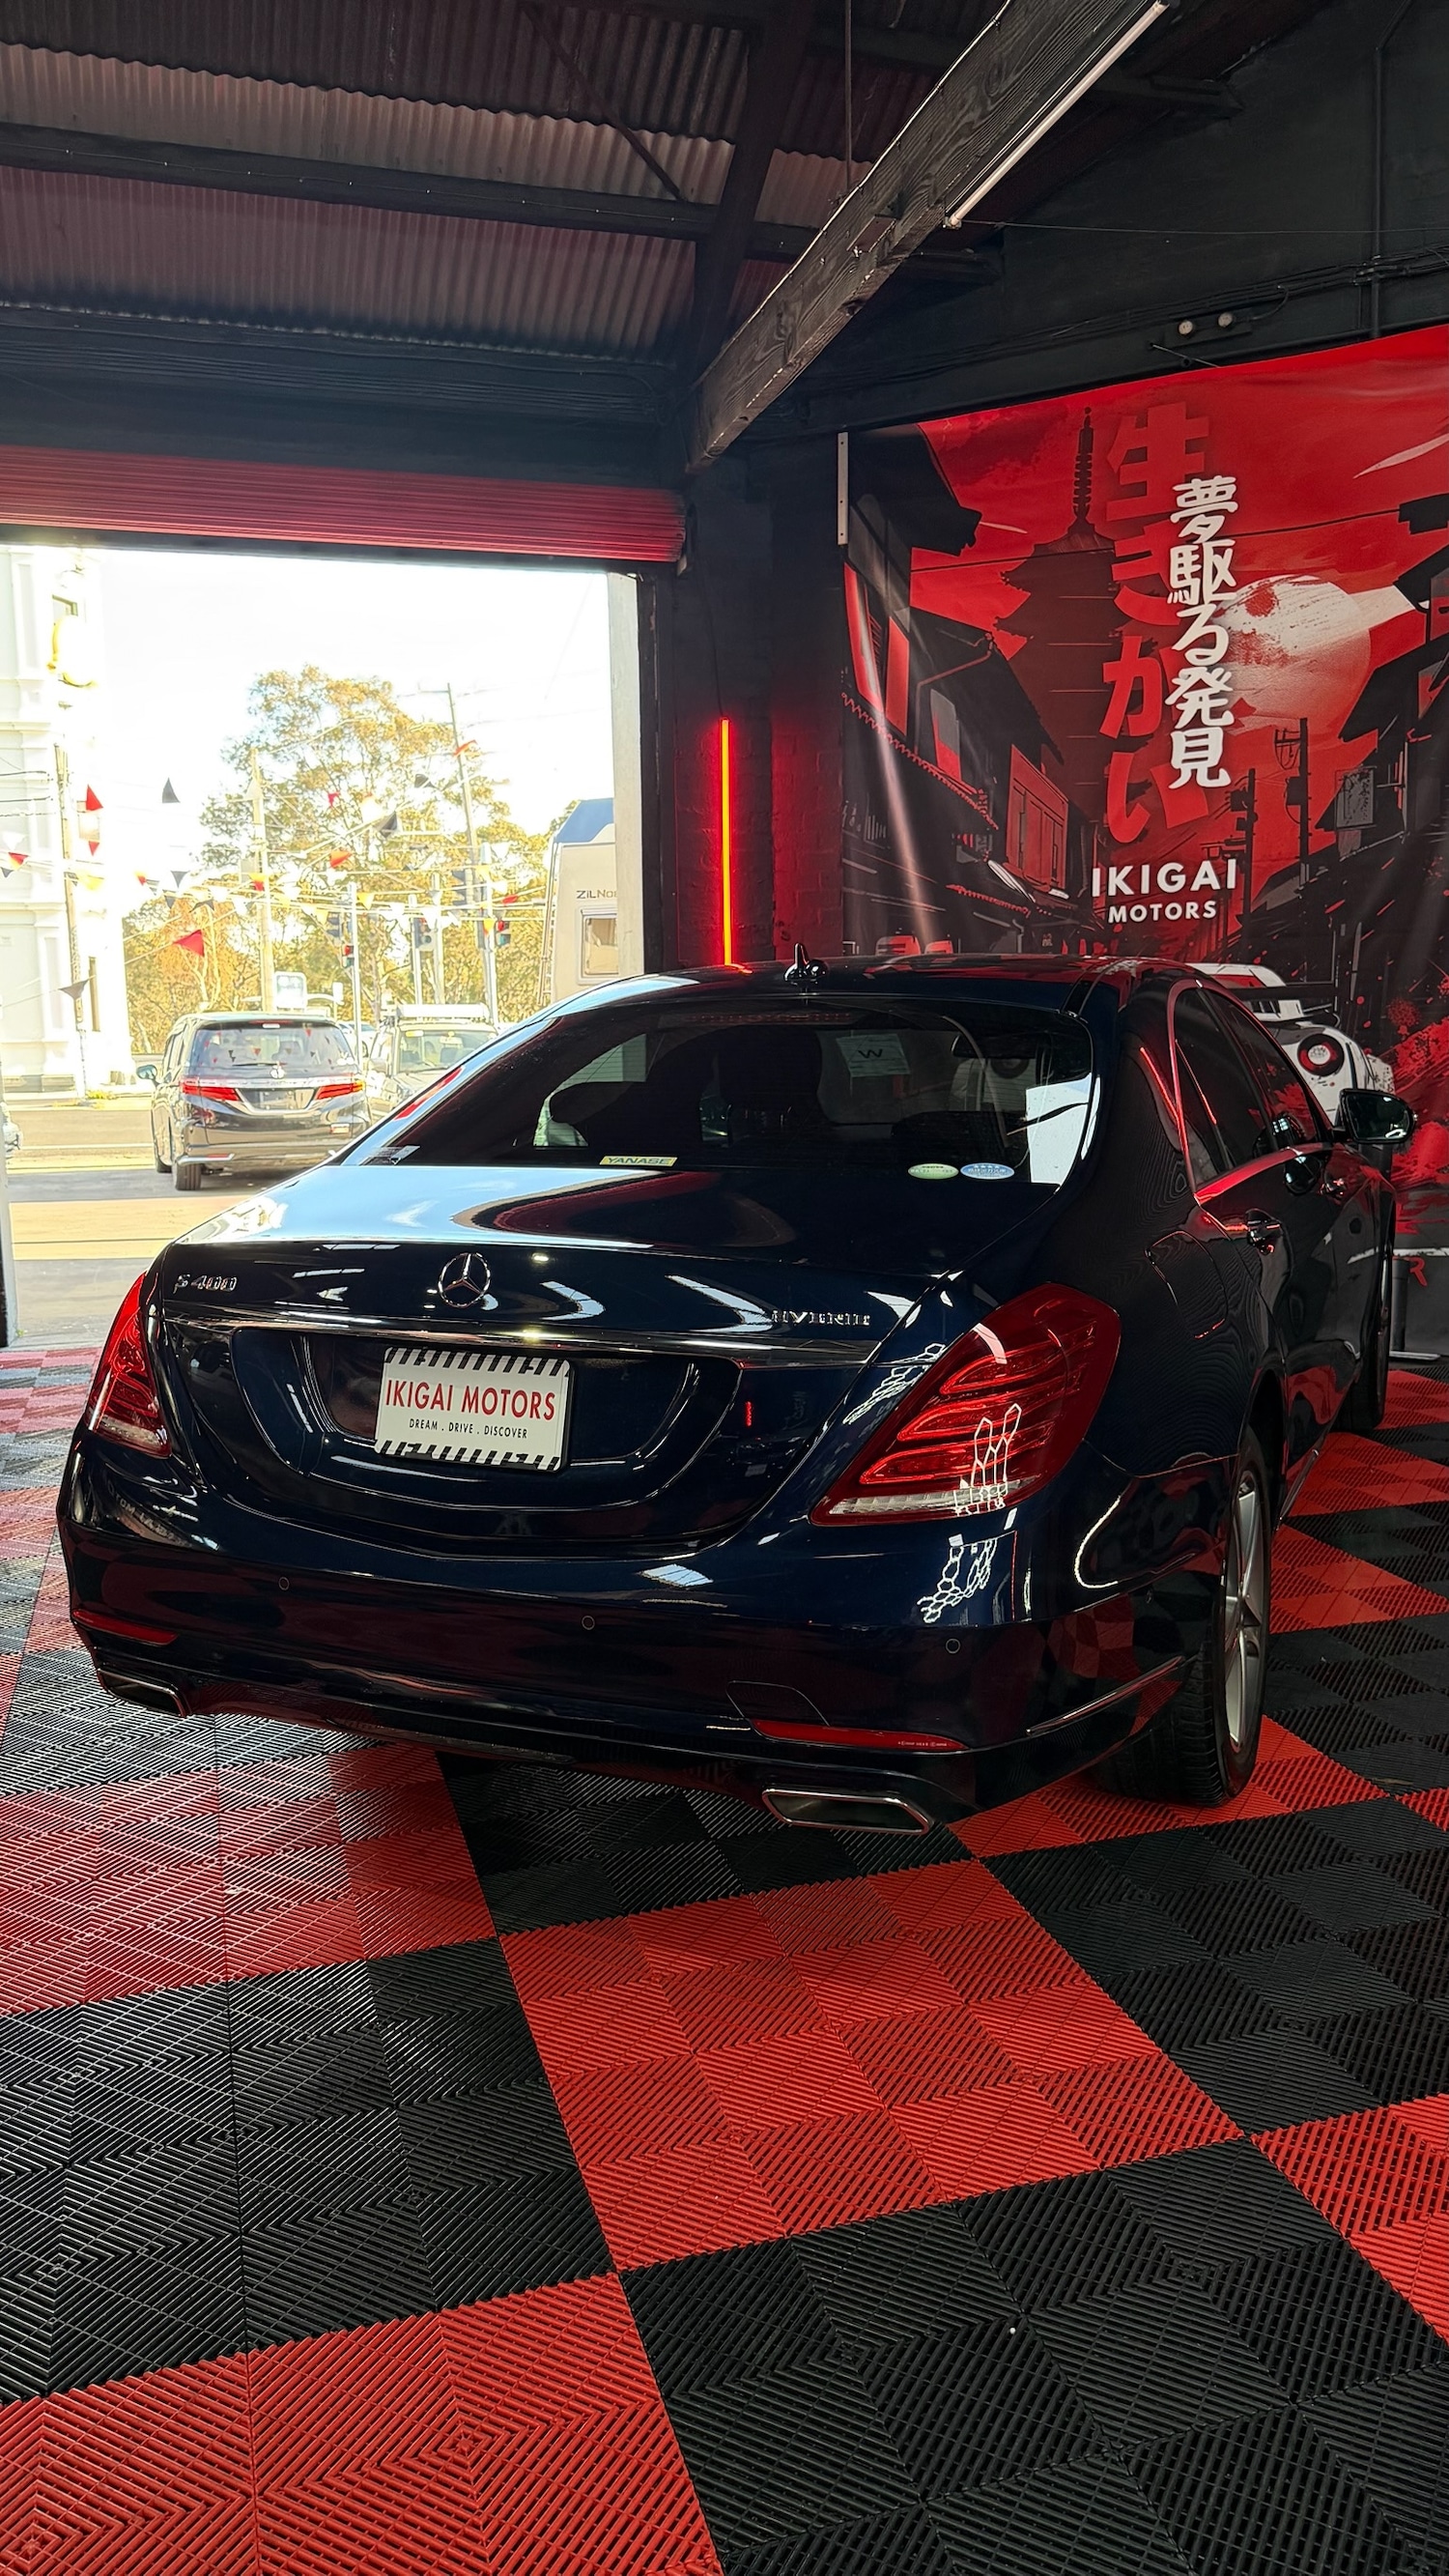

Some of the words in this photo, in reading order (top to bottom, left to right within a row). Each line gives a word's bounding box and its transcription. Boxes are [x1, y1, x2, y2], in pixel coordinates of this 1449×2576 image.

[1165, 475, 1238, 789] 夢駆る発見
[1092, 858, 1237, 898] IKIGAI
[1108, 900, 1217, 924] MOTORS
[173, 1274, 190, 1294] S
[191, 1274, 238, 1292] 400
[385, 1379, 454, 1412] IKIGAI
[460, 1385, 556, 1421] MOTORS
[409, 1417, 439, 1431] DREAM
[447, 1421, 473, 1435] DRIVE
[484, 1425, 528, 1439] DISCOVER
